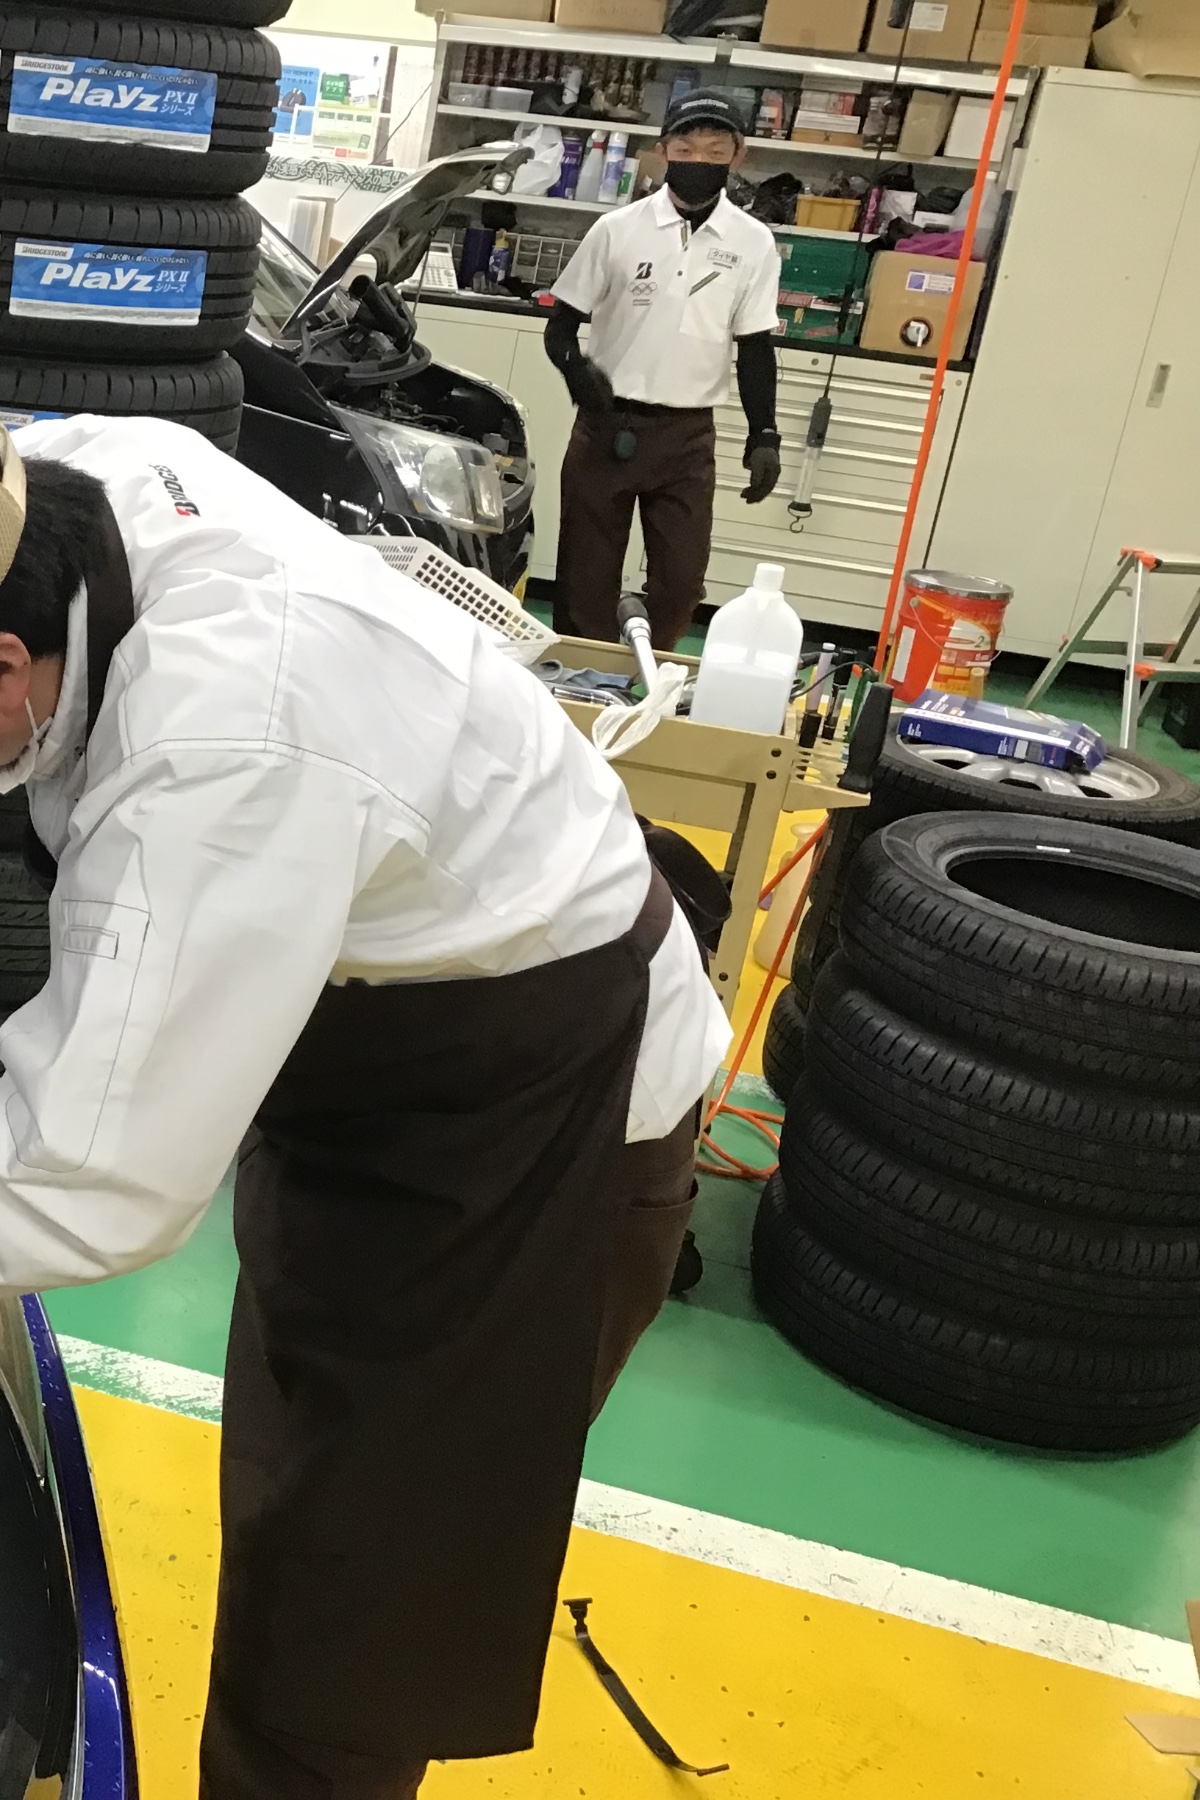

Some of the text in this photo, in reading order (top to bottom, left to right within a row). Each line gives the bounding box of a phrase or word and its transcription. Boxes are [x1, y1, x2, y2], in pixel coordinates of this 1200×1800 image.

[21, 59, 69, 72] BRIDGESTONE
[39, 76, 161, 113] Playz
[163, 90, 185, 103] PX
[160, 104, 195, 116] シリーズ
[21, 246, 68, 258] BRIDGESTONE
[40, 262, 155, 292] Playz
[157, 270, 178, 282] PX
[154, 283, 187, 293] シリーズ
